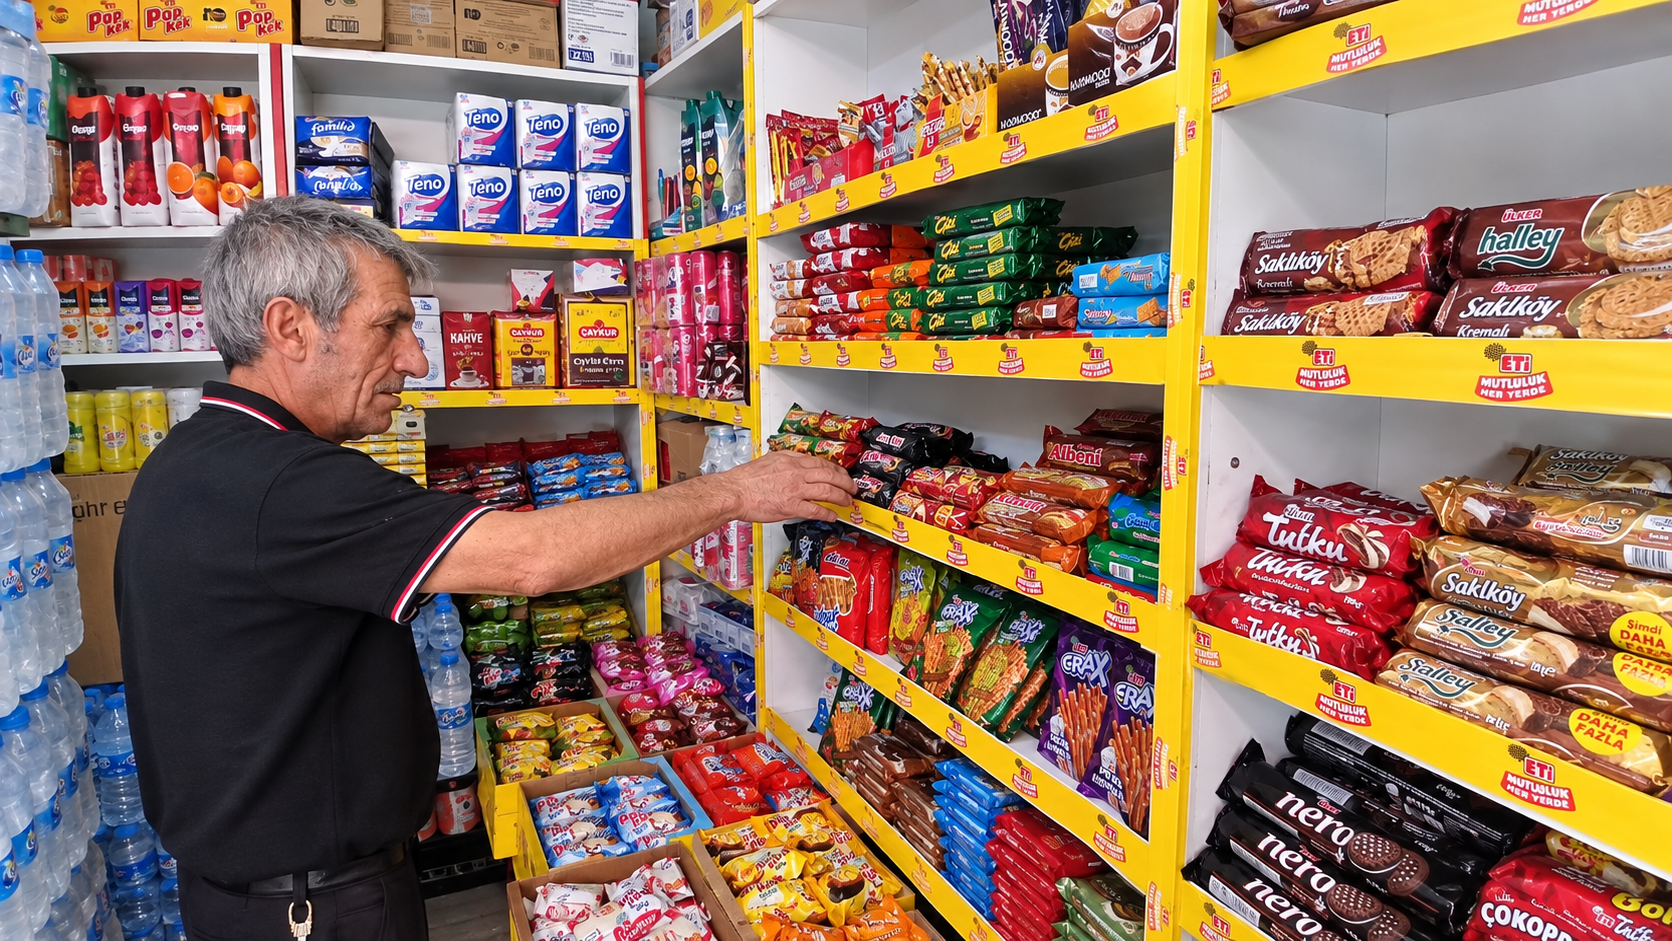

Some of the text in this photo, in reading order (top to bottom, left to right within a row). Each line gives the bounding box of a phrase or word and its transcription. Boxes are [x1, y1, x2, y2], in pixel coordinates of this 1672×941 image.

[465, 109, 500, 126] Teno
[528, 116, 561, 133] Teno
[586, 120, 617, 136] Teno
[407, 176, 442, 192] Teno
[470, 180, 504, 196] Teno
[530, 184, 562, 199] Teno
[586, 187, 618, 201] Teno
[1502, 208, 1542, 222] ÜLKER
[1477, 223, 1564, 262] halley
[451, 333, 483, 343] KAHVE
[1480, 373, 1547, 389] MUTLULUK
[1263, 512, 1348, 562] Tutku
[1627, 619, 1663, 636] Şimdi
[1620, 630, 1666, 650] DAHA
[1062, 650, 1111, 688] CRAX
[1577, 712, 1628, 739] DAHA
[1575, 722, 1624, 751] FAZLA
[1275, 791, 1354, 847] nero
[1258, 832, 1336, 893] nero
[1243, 878, 1322, 935] nero
